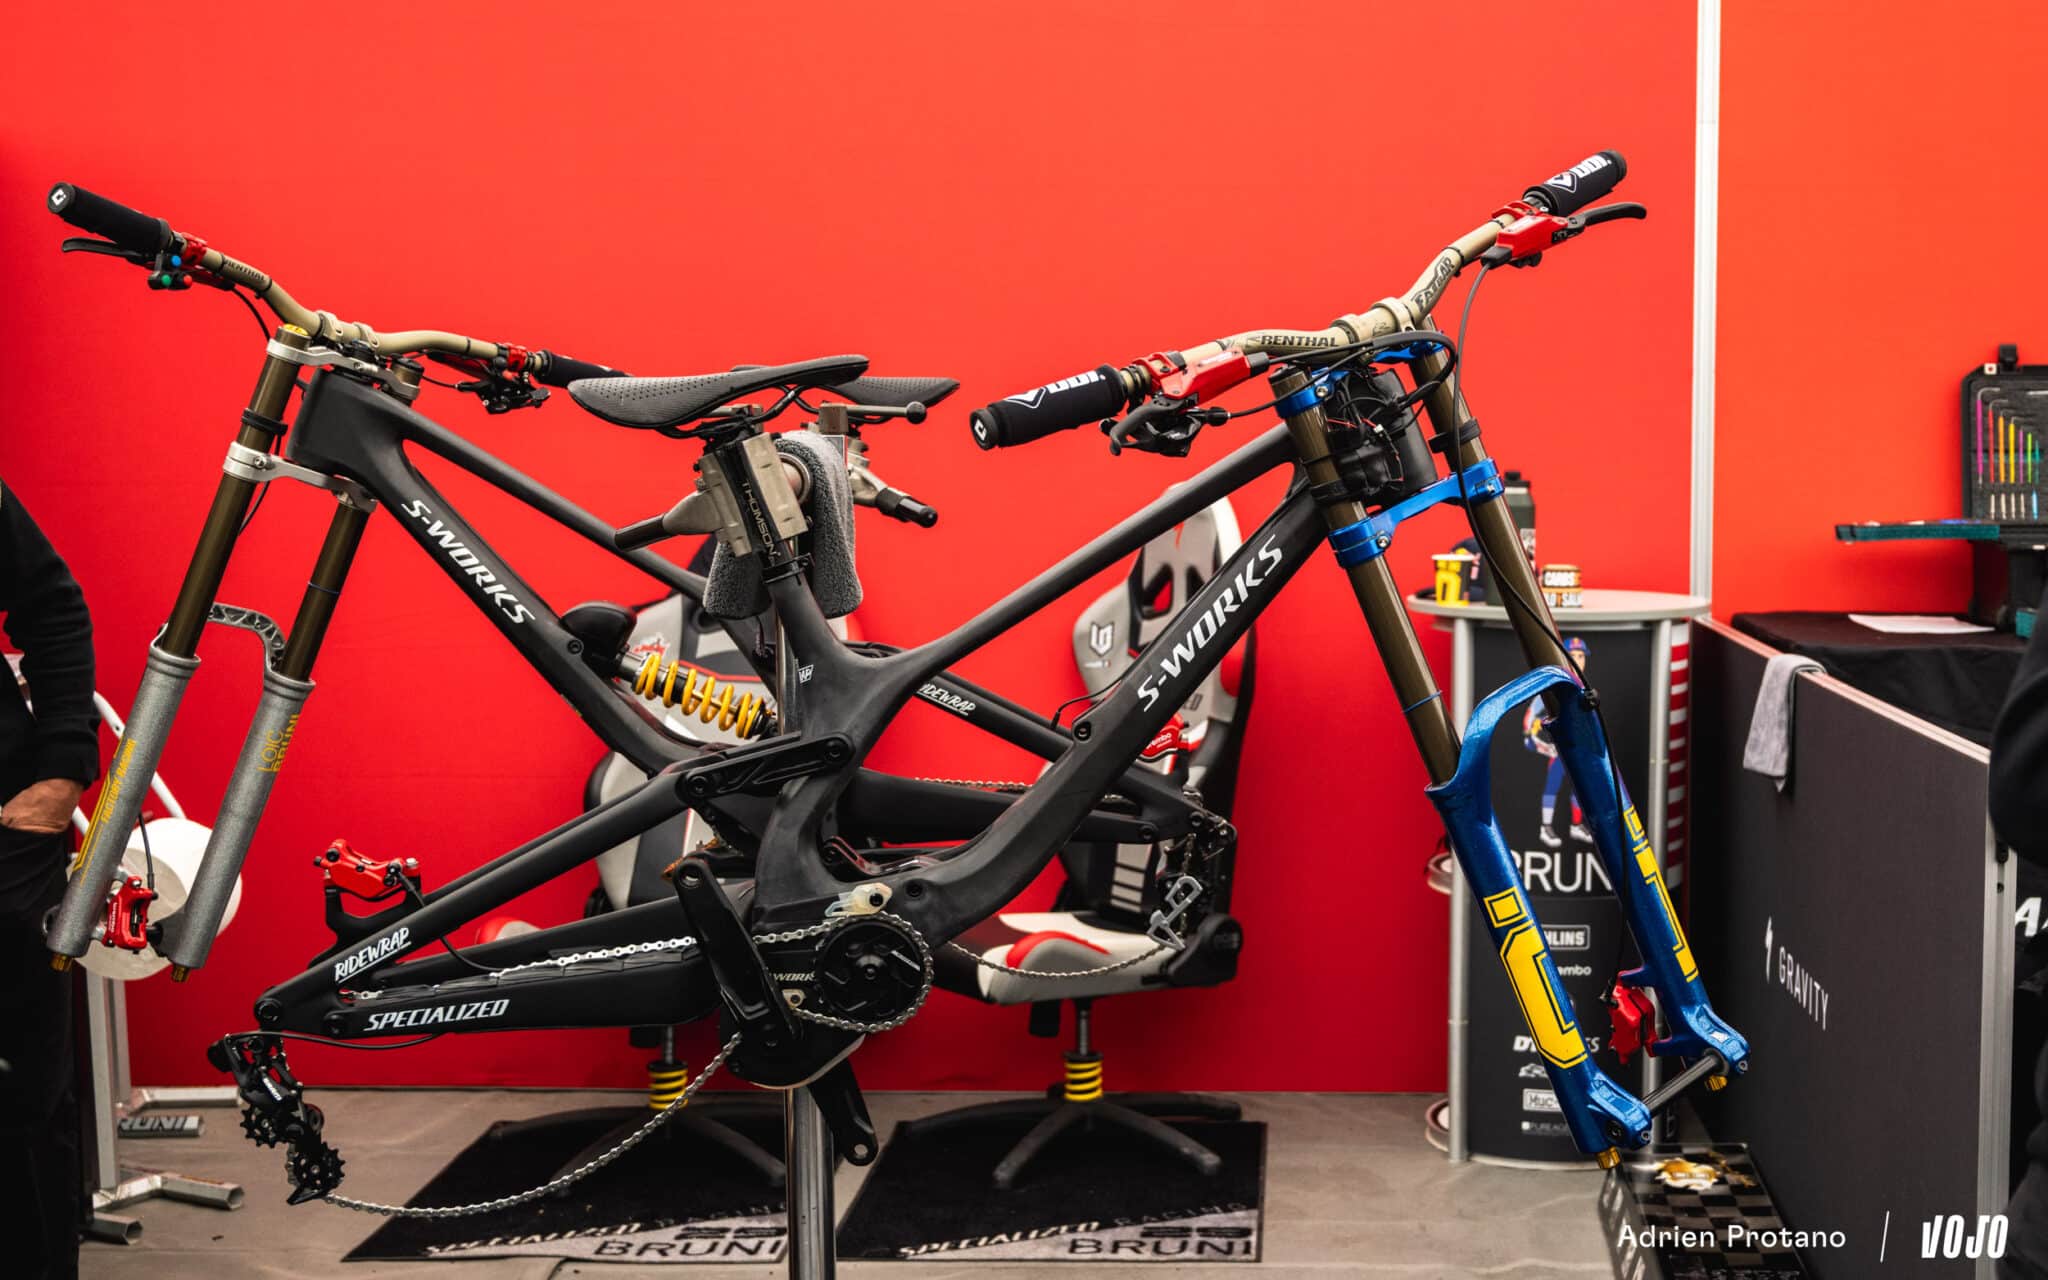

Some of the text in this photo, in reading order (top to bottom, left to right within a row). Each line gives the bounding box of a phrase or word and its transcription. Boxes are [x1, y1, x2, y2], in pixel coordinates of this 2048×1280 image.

[1260, 335, 1339, 348] RENTHAL
[400, 499, 536, 624] S-WORKS
[1137, 534, 1283, 712] S-WORKS
[920, 683, 976, 712] IDEWRAP
[1511, 850, 1612, 893] RUN
[334, 927, 410, 982] RIDEWRAP
[1779, 945, 1829, 1031] GRAVITY
[363, 999, 510, 1032] SPECIALIZED
[594, 1239, 784, 1257] BRUNI
[1069, 1239, 1252, 1256] BRUNI
